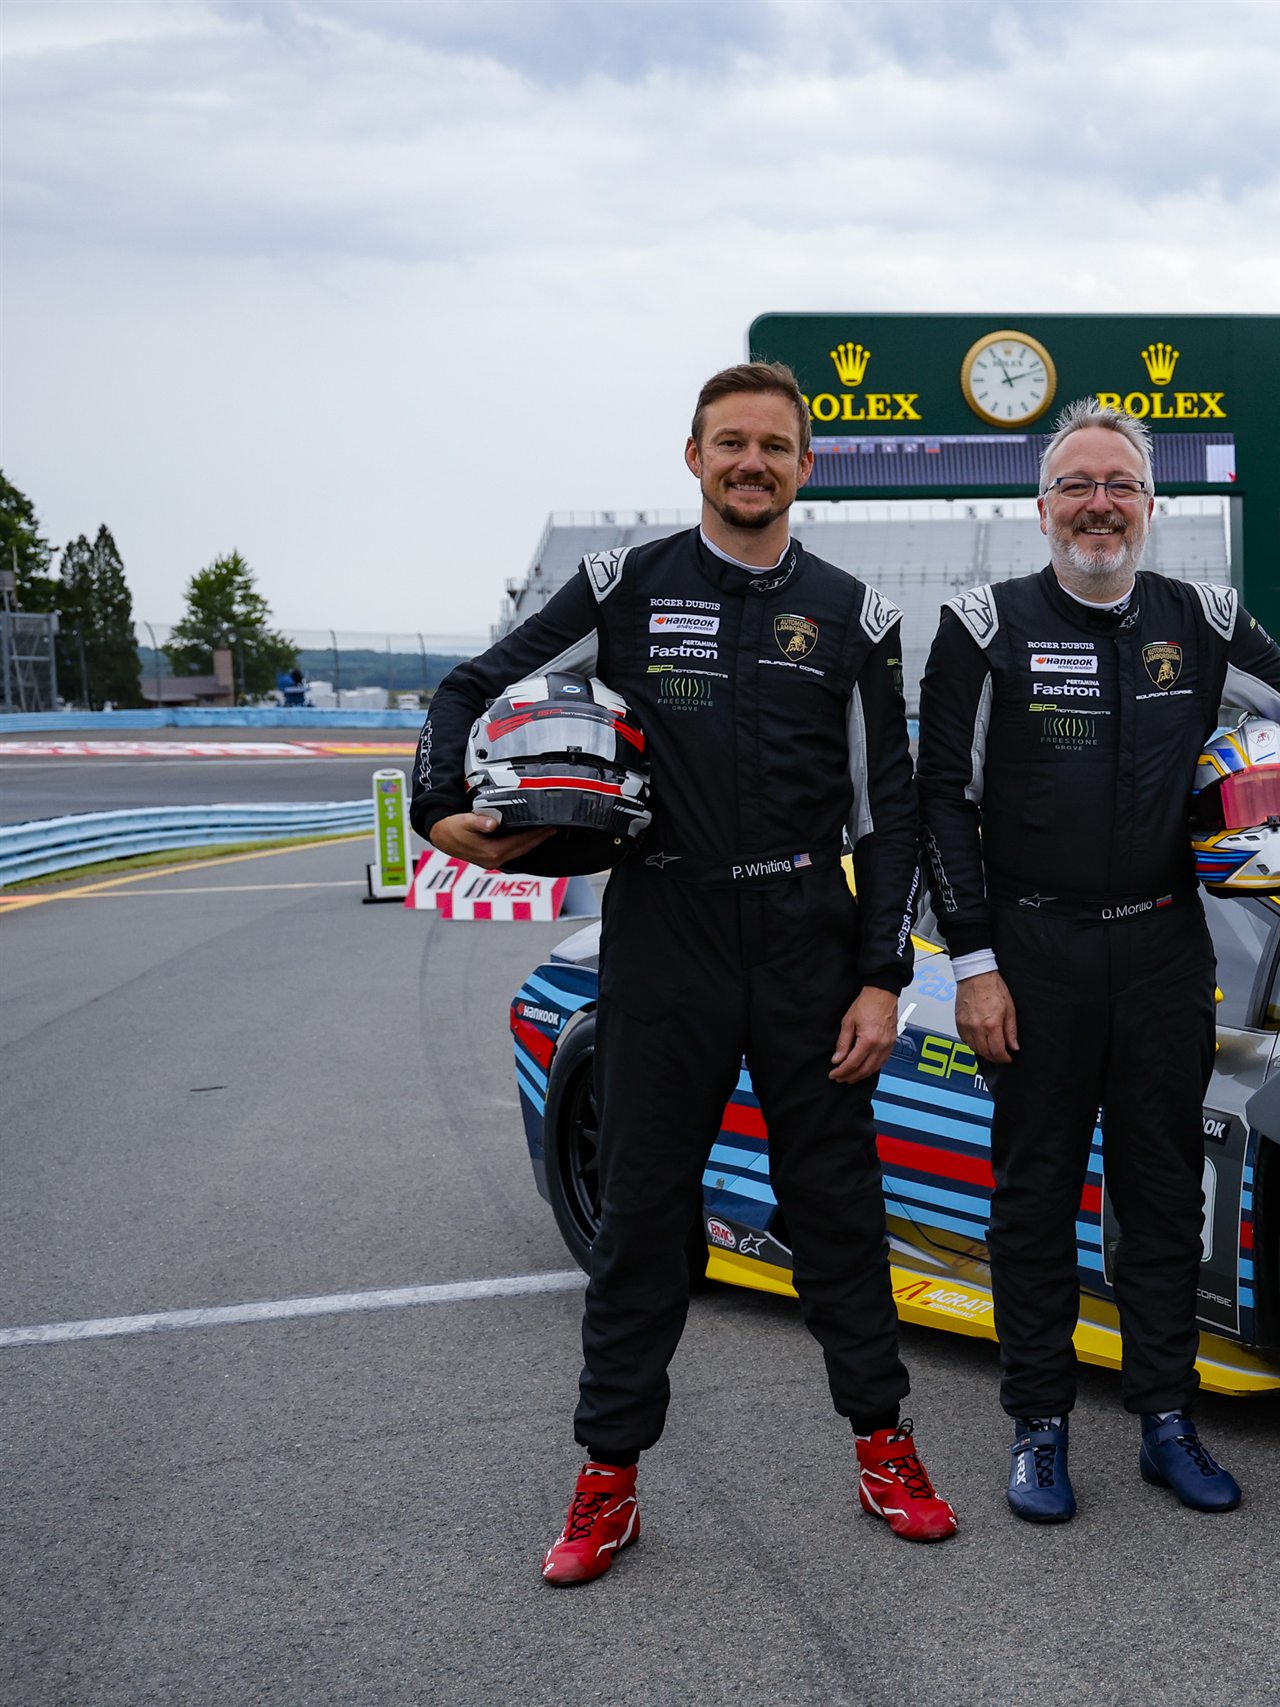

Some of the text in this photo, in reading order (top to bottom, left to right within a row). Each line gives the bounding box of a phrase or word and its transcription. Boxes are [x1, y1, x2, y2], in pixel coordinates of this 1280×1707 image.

[650, 599, 720, 610] ROGER DUBUIS
[682, 640, 718, 648] PERTAMINA
[1027, 641, 1094, 650] ROGER DUBUIS
[650, 646, 718, 659] Fastron
[1033, 683, 1100, 697] Fastron
[732, 860, 792, 879] P. Whiting
[488, 881, 541, 896] IMSA
[1102, 901, 1153, 919] D. Morillo
[917, 1035, 978, 1079] SP
[710, 1222, 733, 1244] BMC
[1016, 1452, 1026, 1486] HRX
